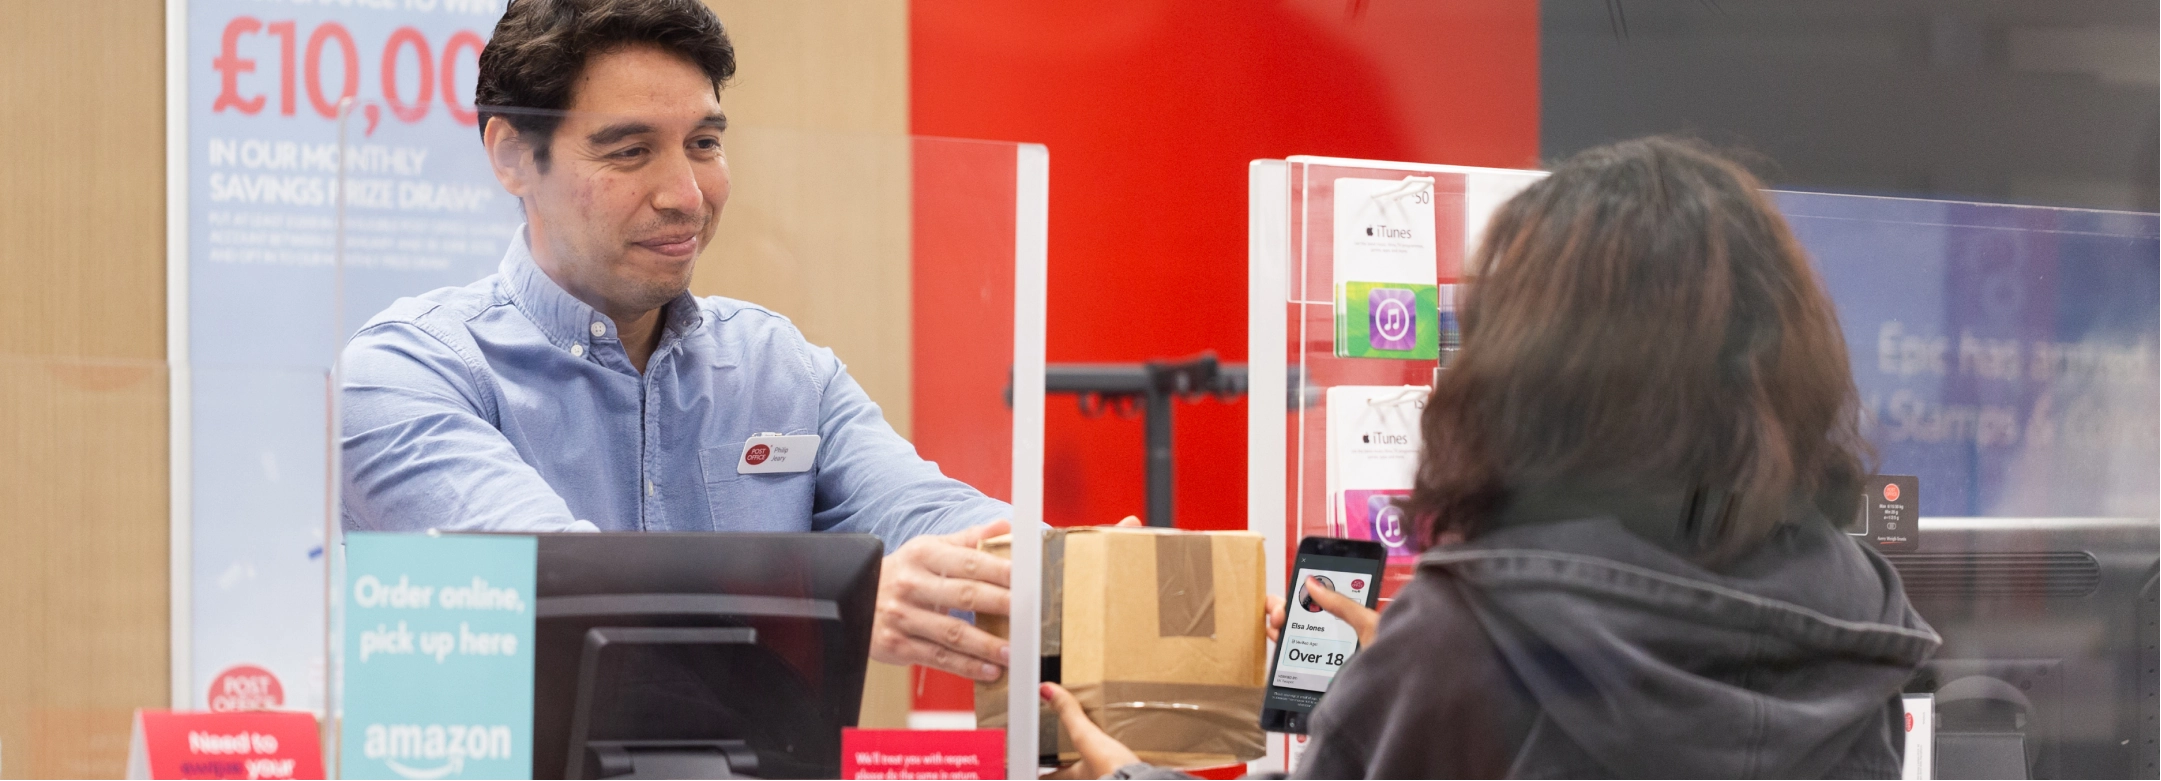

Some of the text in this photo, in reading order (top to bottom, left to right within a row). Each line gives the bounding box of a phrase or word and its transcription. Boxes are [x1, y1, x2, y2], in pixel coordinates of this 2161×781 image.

[209, 138, 428, 176] IN OUR MONTHLY
[209, 174, 322, 206] SAVINGS
[1411, 191, 1430, 205] 50
[1376, 225, 1412, 239] iTunes
[1373, 431, 1408, 445] iTunes
[774, 446, 788, 454] Philip
[354, 575, 526, 613] Order online,
[1291, 622, 1325, 632] Elsa Jones
[359, 622, 519, 663] pick up here
[1289, 648, 1344, 666] Over 18
[223, 675, 270, 697] POST
[188, 730, 279, 755] Need to
[364, 723, 512, 760] amazon
[245, 758, 297, 780] your
[855, 752, 881, 766] We'll
[881, 754, 902, 766] treat
[903, 755, 920, 768] you
[922, 752, 942, 766] with
[886, 767, 897, 780] do
[899, 767, 915, 780] the
